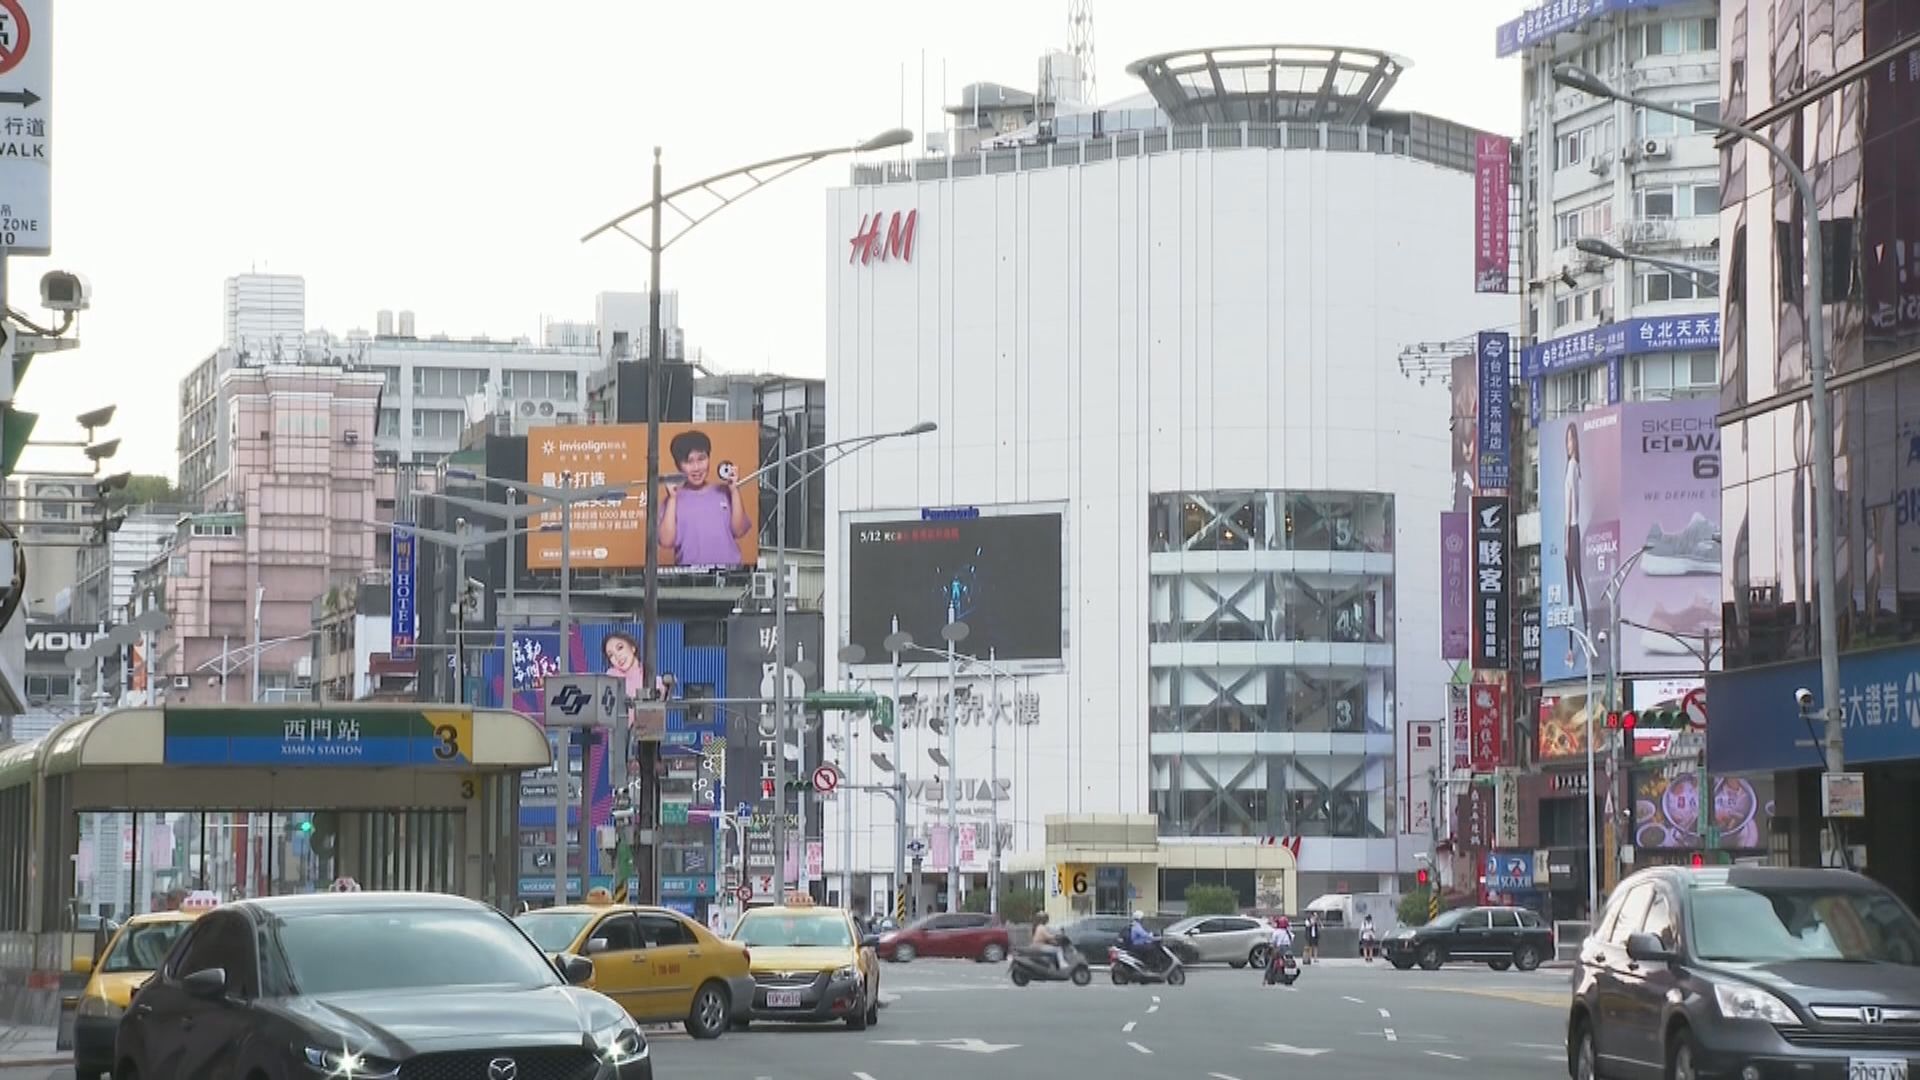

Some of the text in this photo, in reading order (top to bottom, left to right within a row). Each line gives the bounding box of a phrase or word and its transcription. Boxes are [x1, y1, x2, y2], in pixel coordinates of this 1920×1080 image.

[0, 117, 45, 137] 行道
[3, 218, 38, 231] ZONE
[0, 232, 15, 245] 0
[849, 208, 917, 266] H&M
[1647, 337, 1677, 348] TAIPEI
[560, 440, 606, 453] invisalign
[1692, 454, 1720, 479] 6
[397, 573, 410, 633] HOTEL
[284, 717, 361, 742] 西門站
[280, 744, 363, 756] XIMEN STATION
[434, 724, 460, 760] 3
[461, 779, 475, 800] 3
[522, 882, 556, 891] watson
[1073, 872, 1088, 894] 6
